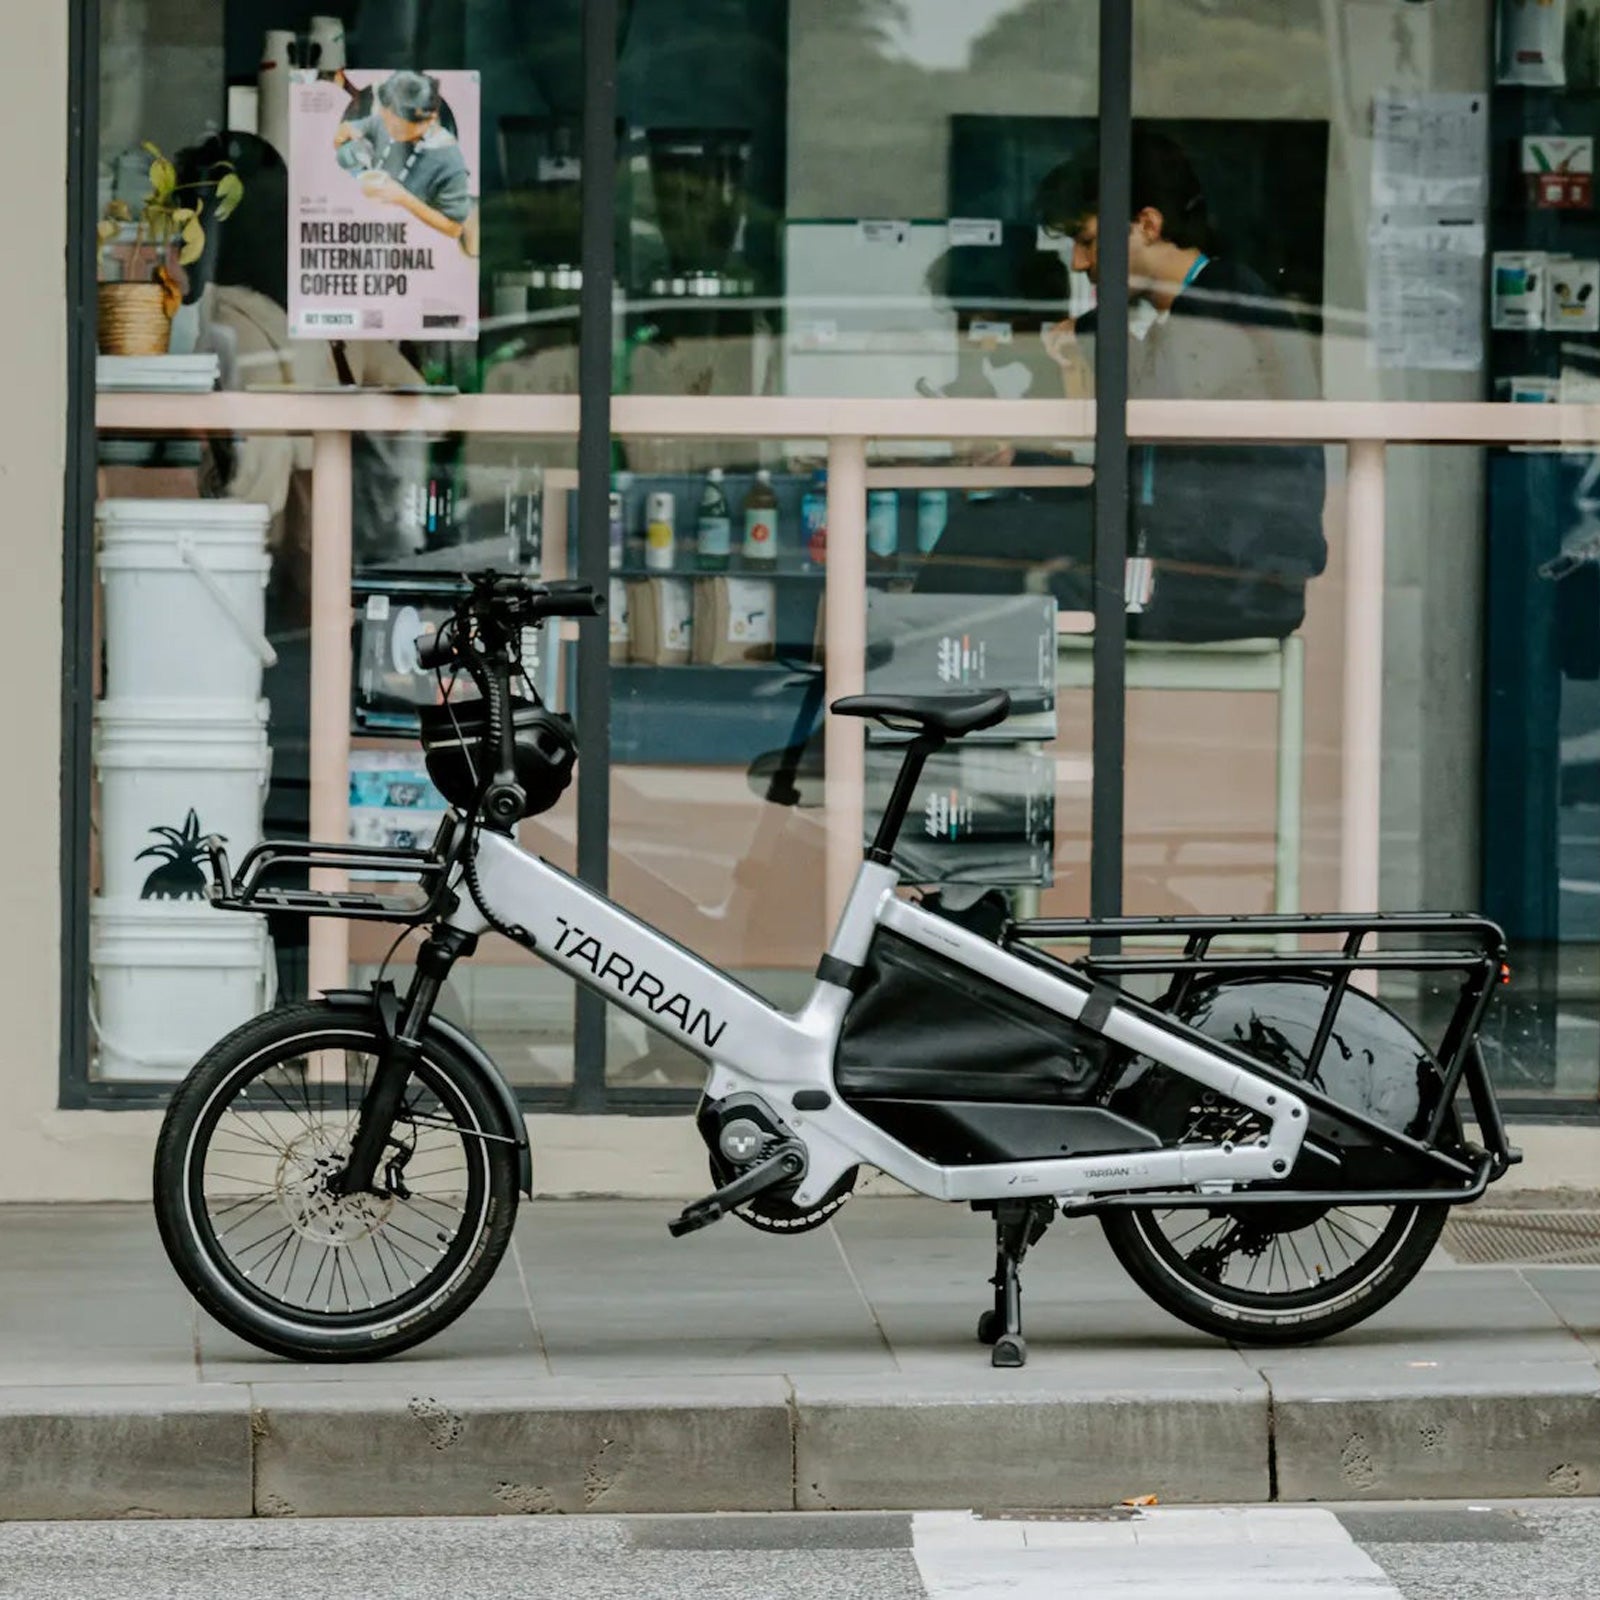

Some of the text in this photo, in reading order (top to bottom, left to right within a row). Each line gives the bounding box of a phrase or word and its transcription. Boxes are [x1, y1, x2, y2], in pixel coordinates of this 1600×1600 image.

[300, 222, 408, 244] MELBOURNE
[300, 248, 435, 271] INTERNATIONAL
[300, 273, 408, 296] COFFEE EXPO
[554, 916, 728, 1048] TARRAN
[1083, 1167, 1130, 1178] TARRAN
